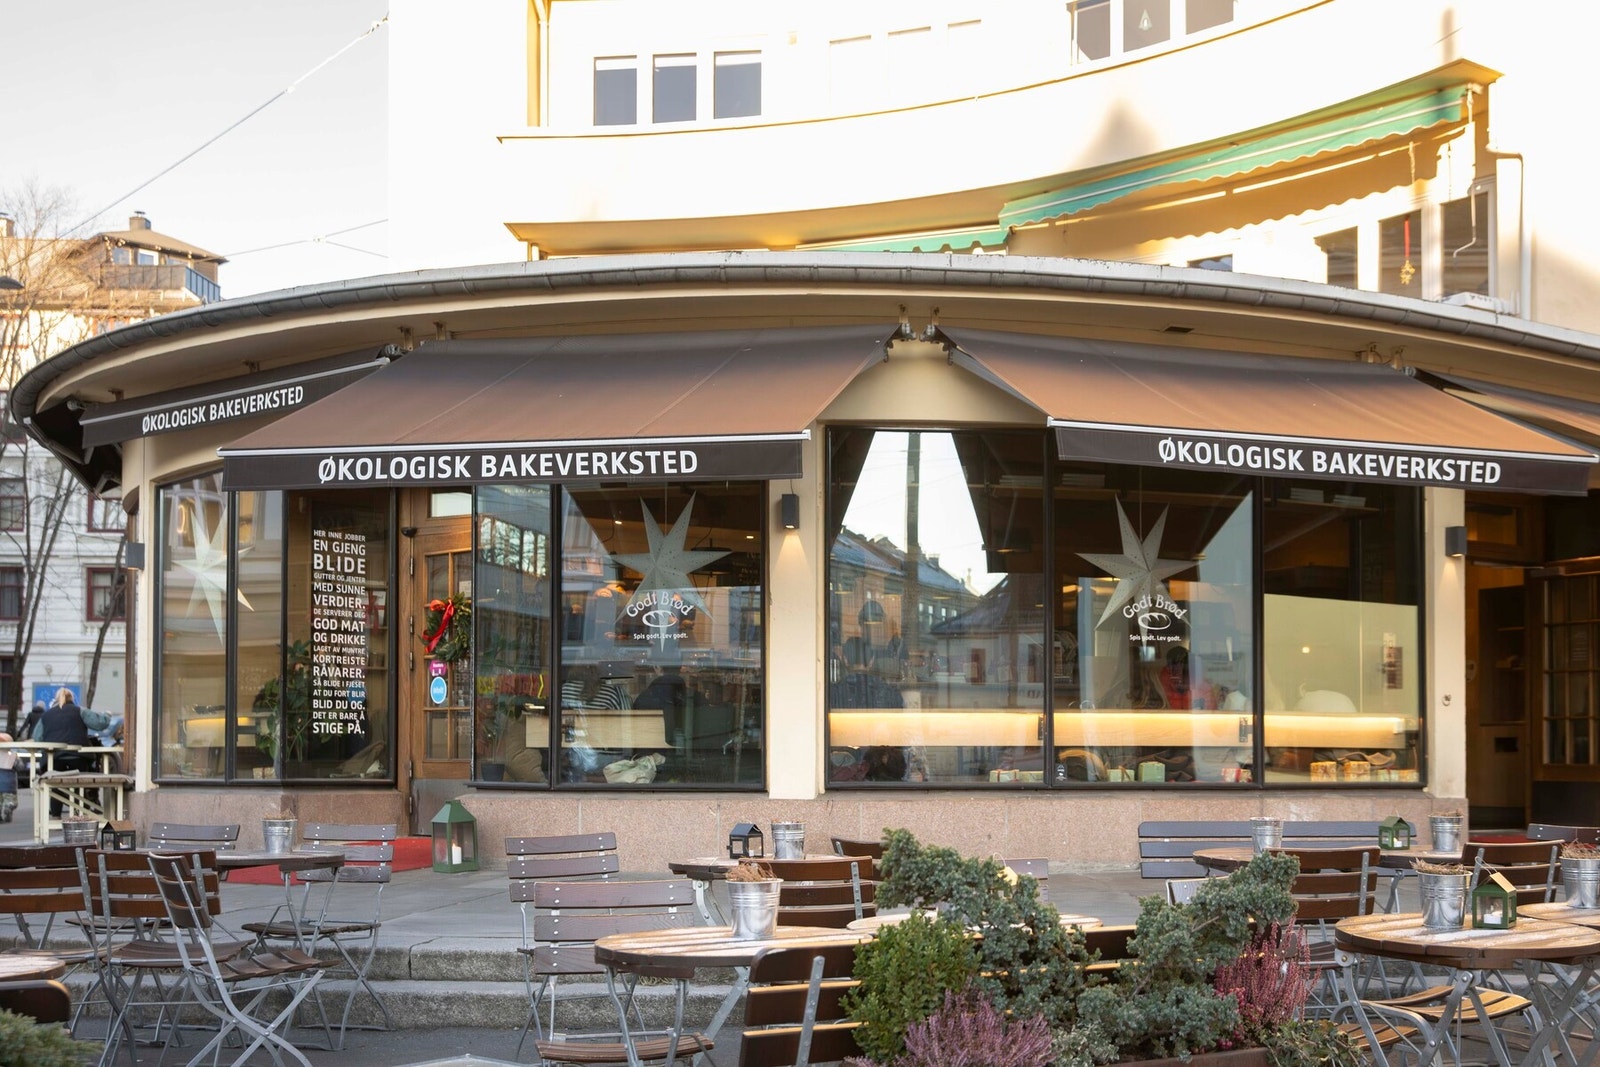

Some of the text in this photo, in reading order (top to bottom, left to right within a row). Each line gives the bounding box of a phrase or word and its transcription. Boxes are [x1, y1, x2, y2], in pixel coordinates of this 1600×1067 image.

[142, 385, 304, 435] ØKOLOGISK BAKEVERKSTED
[318, 450, 698, 484] ØKOLOGISK BAKEVERKSTED
[1158, 437, 1501, 484] ØKOLOGISK BAKEVERKSTED
[345, 534, 366, 542] JOBBER
[314, 539, 366, 555] EN GJENG
[314, 553, 366, 574] BLIDE
[314, 582, 365, 595] MED SUNNE
[314, 594, 365, 609] VERDIER.
[626, 591, 695, 617] Godt Brød
[1123, 594, 1188, 619] Godt Brød
[323, 609, 352, 617] SERVERER
[314, 618, 365, 632] GOD MAT
[314, 632, 365, 645] OG DRIKKE
[314, 654, 365, 665] KORTREISTE
[313, 664, 365, 678] RÅVARER.
[313, 678, 321, 686] SÅ
[313, 699, 365, 710] BLID DU OG.
[360, 711, 365, 720] Å
[313, 720, 365, 734] STIGE PÅ.
